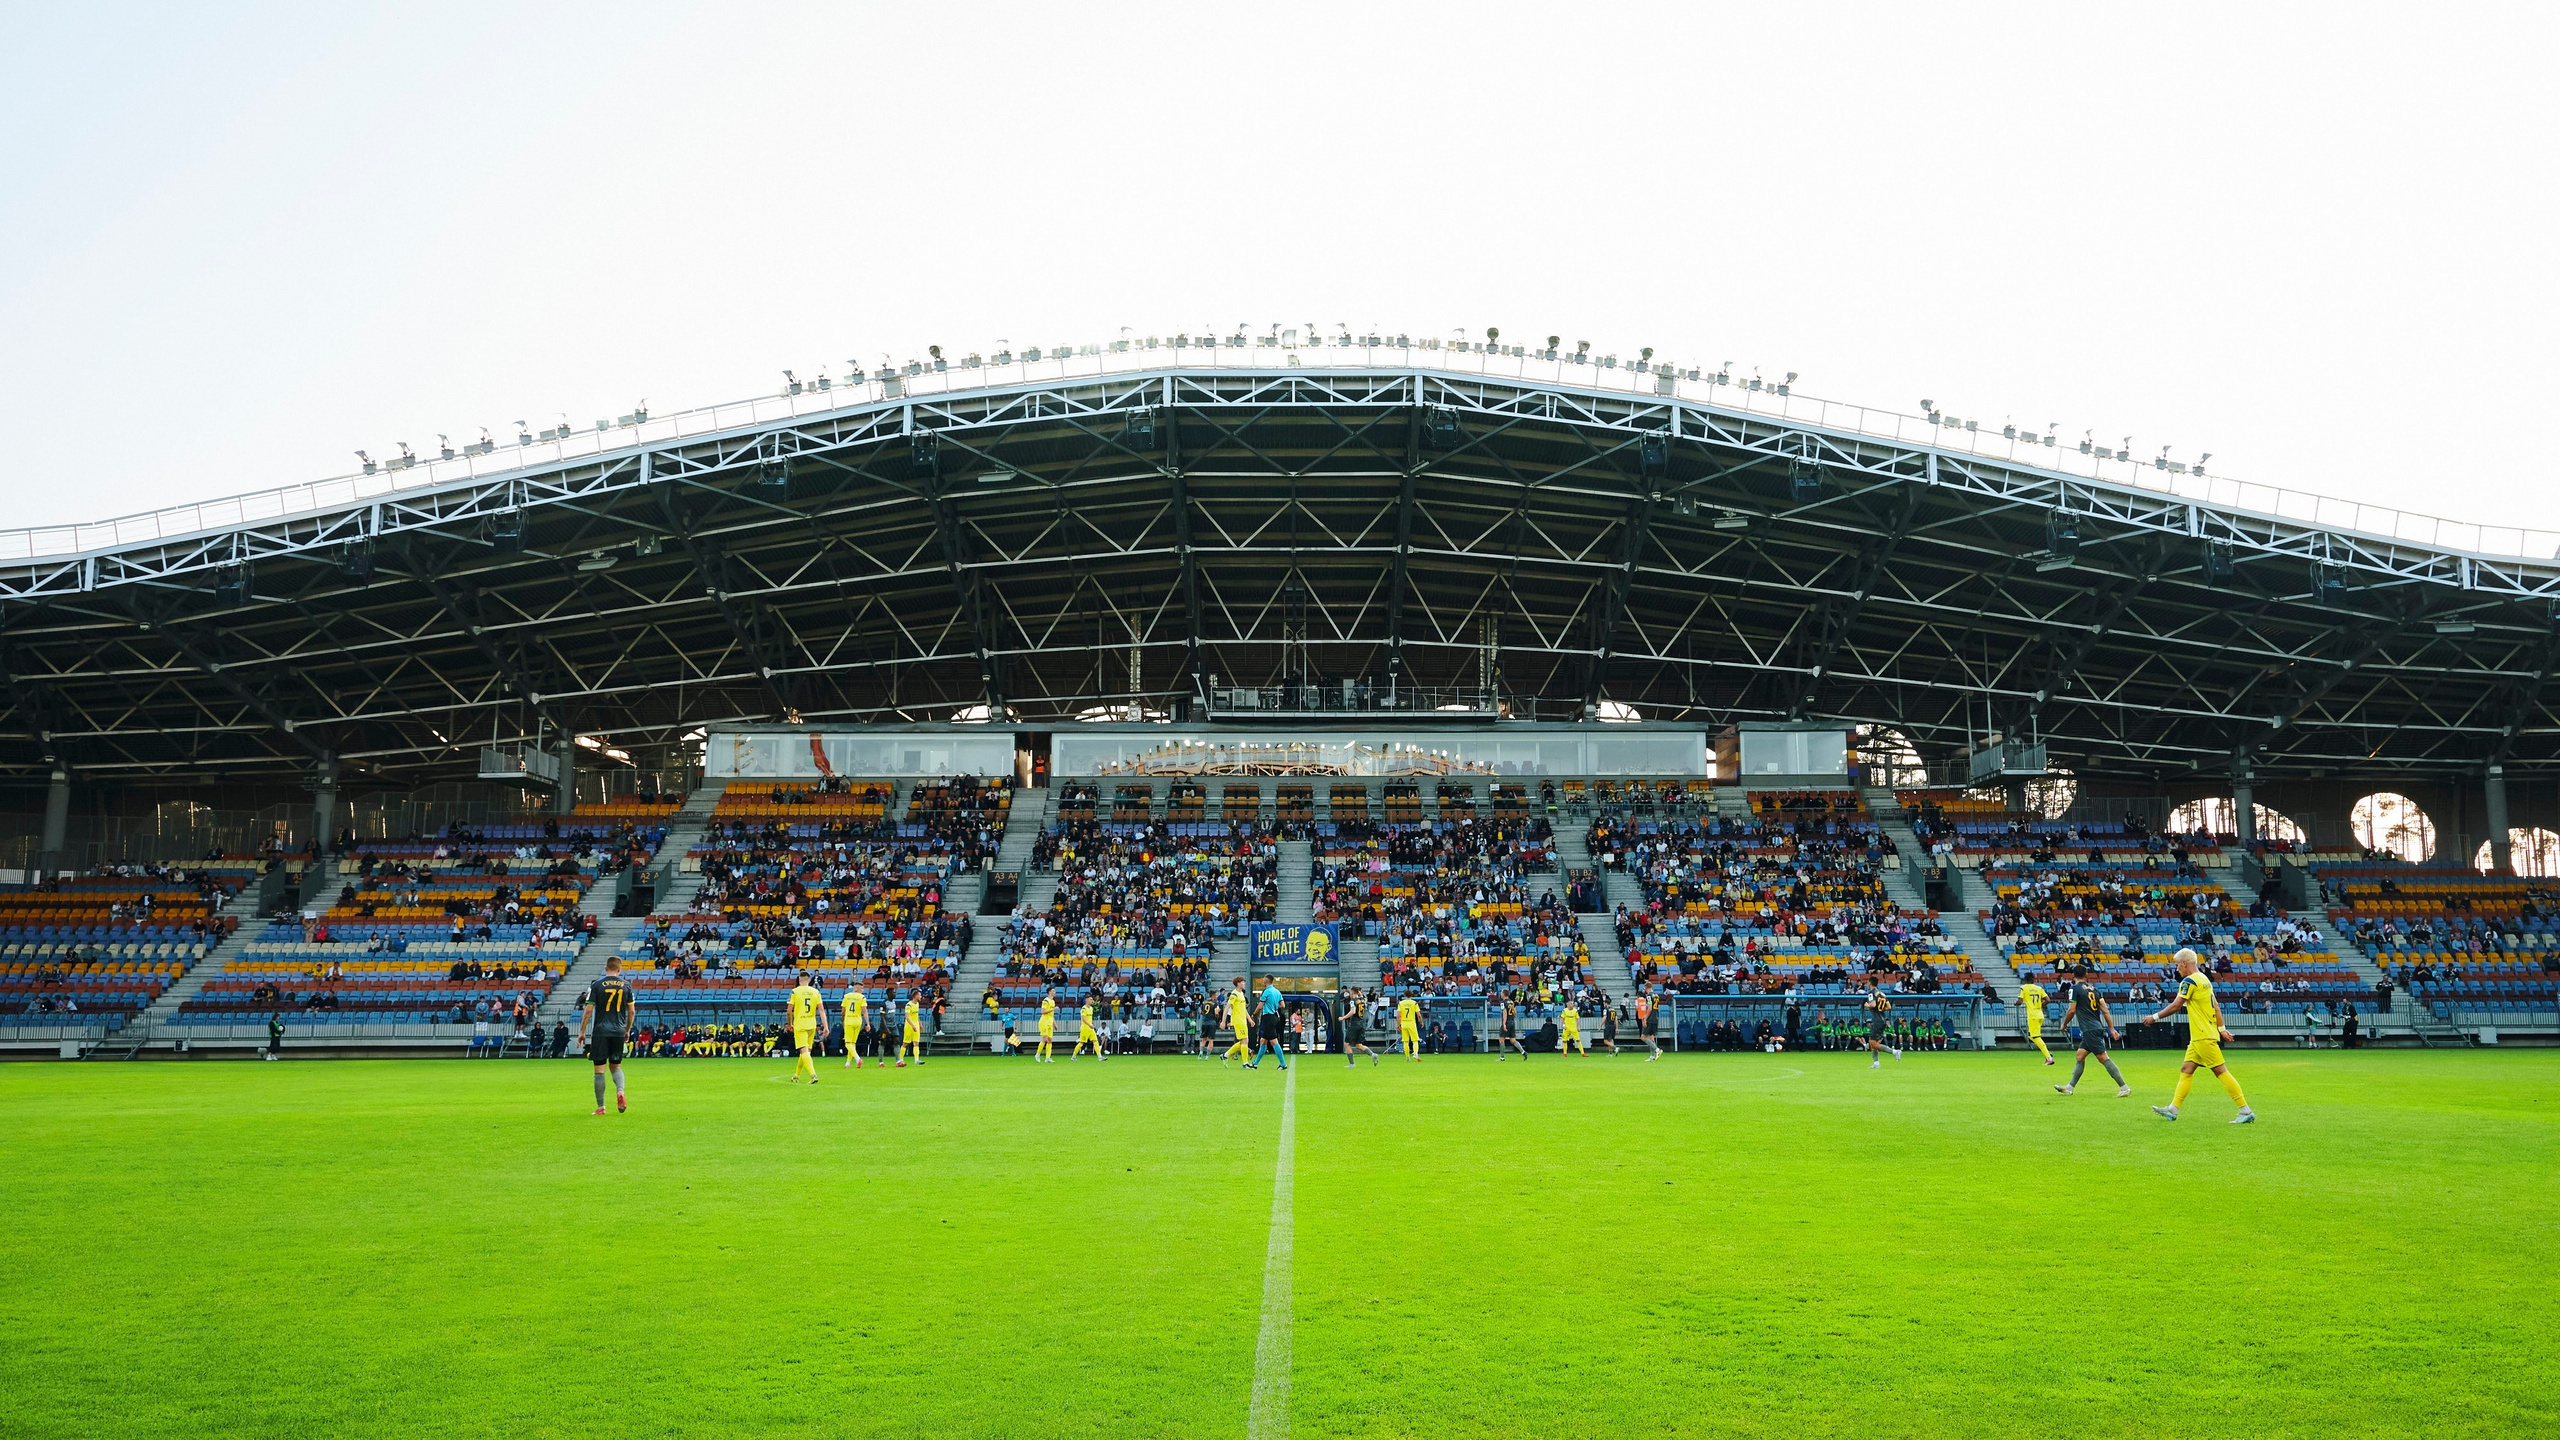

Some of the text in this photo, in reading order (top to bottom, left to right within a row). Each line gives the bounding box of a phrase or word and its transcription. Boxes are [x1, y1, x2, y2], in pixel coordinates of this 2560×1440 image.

[994, 872, 1018, 880] A3 A4
[1570, 869, 1593, 877] B1 B2
[1930, 868, 1941, 876] B3
[1257, 926, 1301, 943] HOME OF
[1257, 940, 1300, 959] FC BATE
[604, 988, 624, 1013] 71
[804, 998, 811, 1014] 5
[2088, 991, 2098, 1012] 8
[849, 1002, 856, 1013] 4
[1204, 1004, 1211, 1015] 9
[1405, 1008, 1410, 1018] 7
